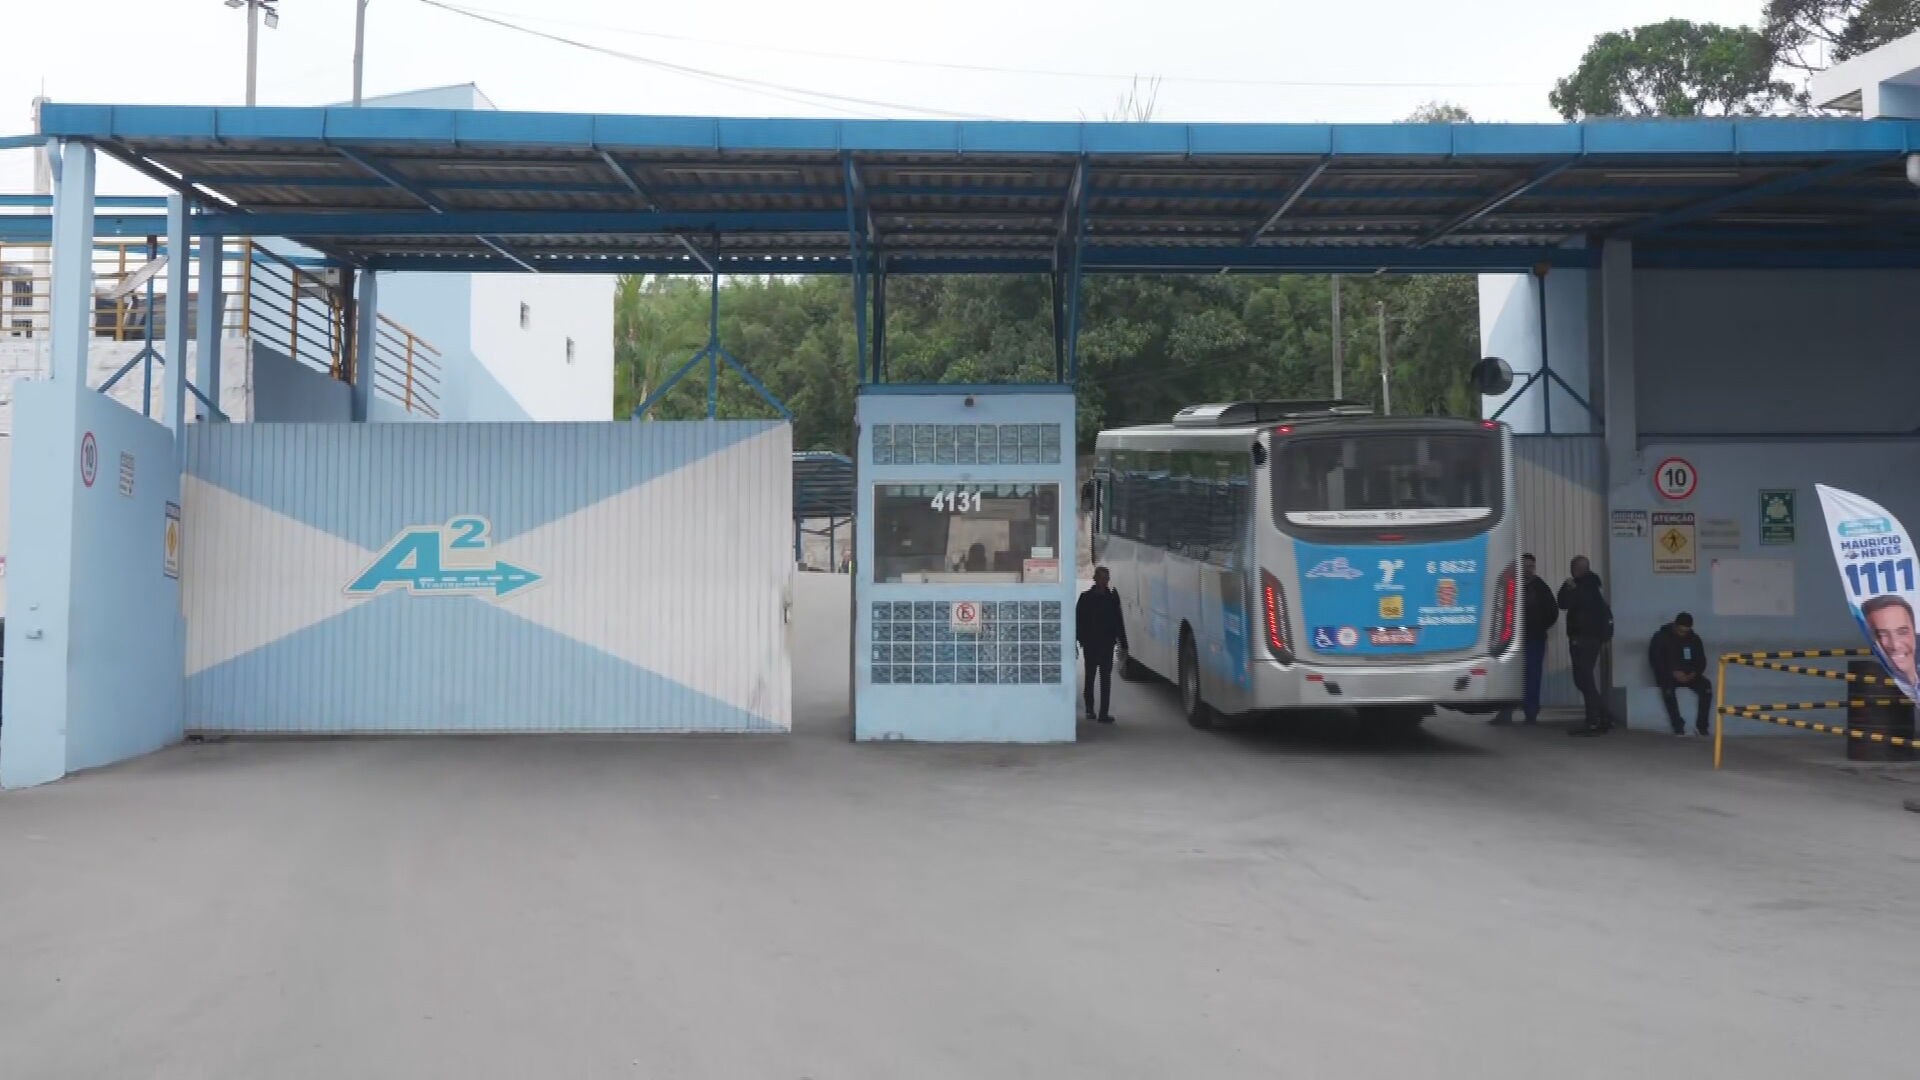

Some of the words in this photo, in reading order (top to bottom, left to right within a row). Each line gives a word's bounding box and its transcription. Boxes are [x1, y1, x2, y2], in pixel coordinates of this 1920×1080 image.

[1665, 468, 1687, 487] 10
[931, 490, 981, 512] 4131
[1653, 514, 1694, 524] ATENÇÃO
[1861, 545, 1902, 559] NEVES
[1845, 558, 1915, 596] 1111
